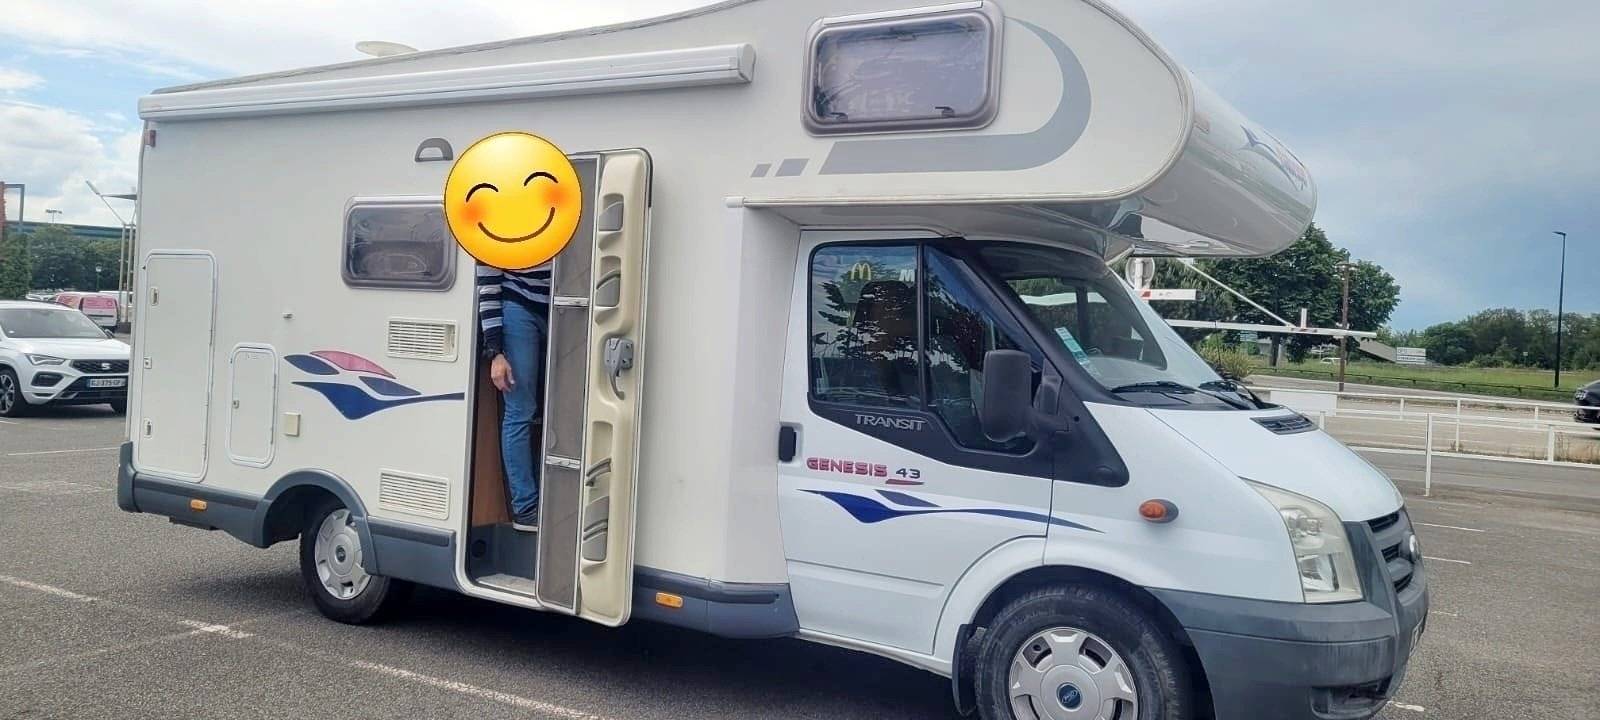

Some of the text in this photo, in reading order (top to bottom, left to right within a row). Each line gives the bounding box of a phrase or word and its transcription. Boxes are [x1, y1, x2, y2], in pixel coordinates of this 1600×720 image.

[855, 414, 926, 430] TRANSIT
[807, 457, 921, 479] GENESIS 43
